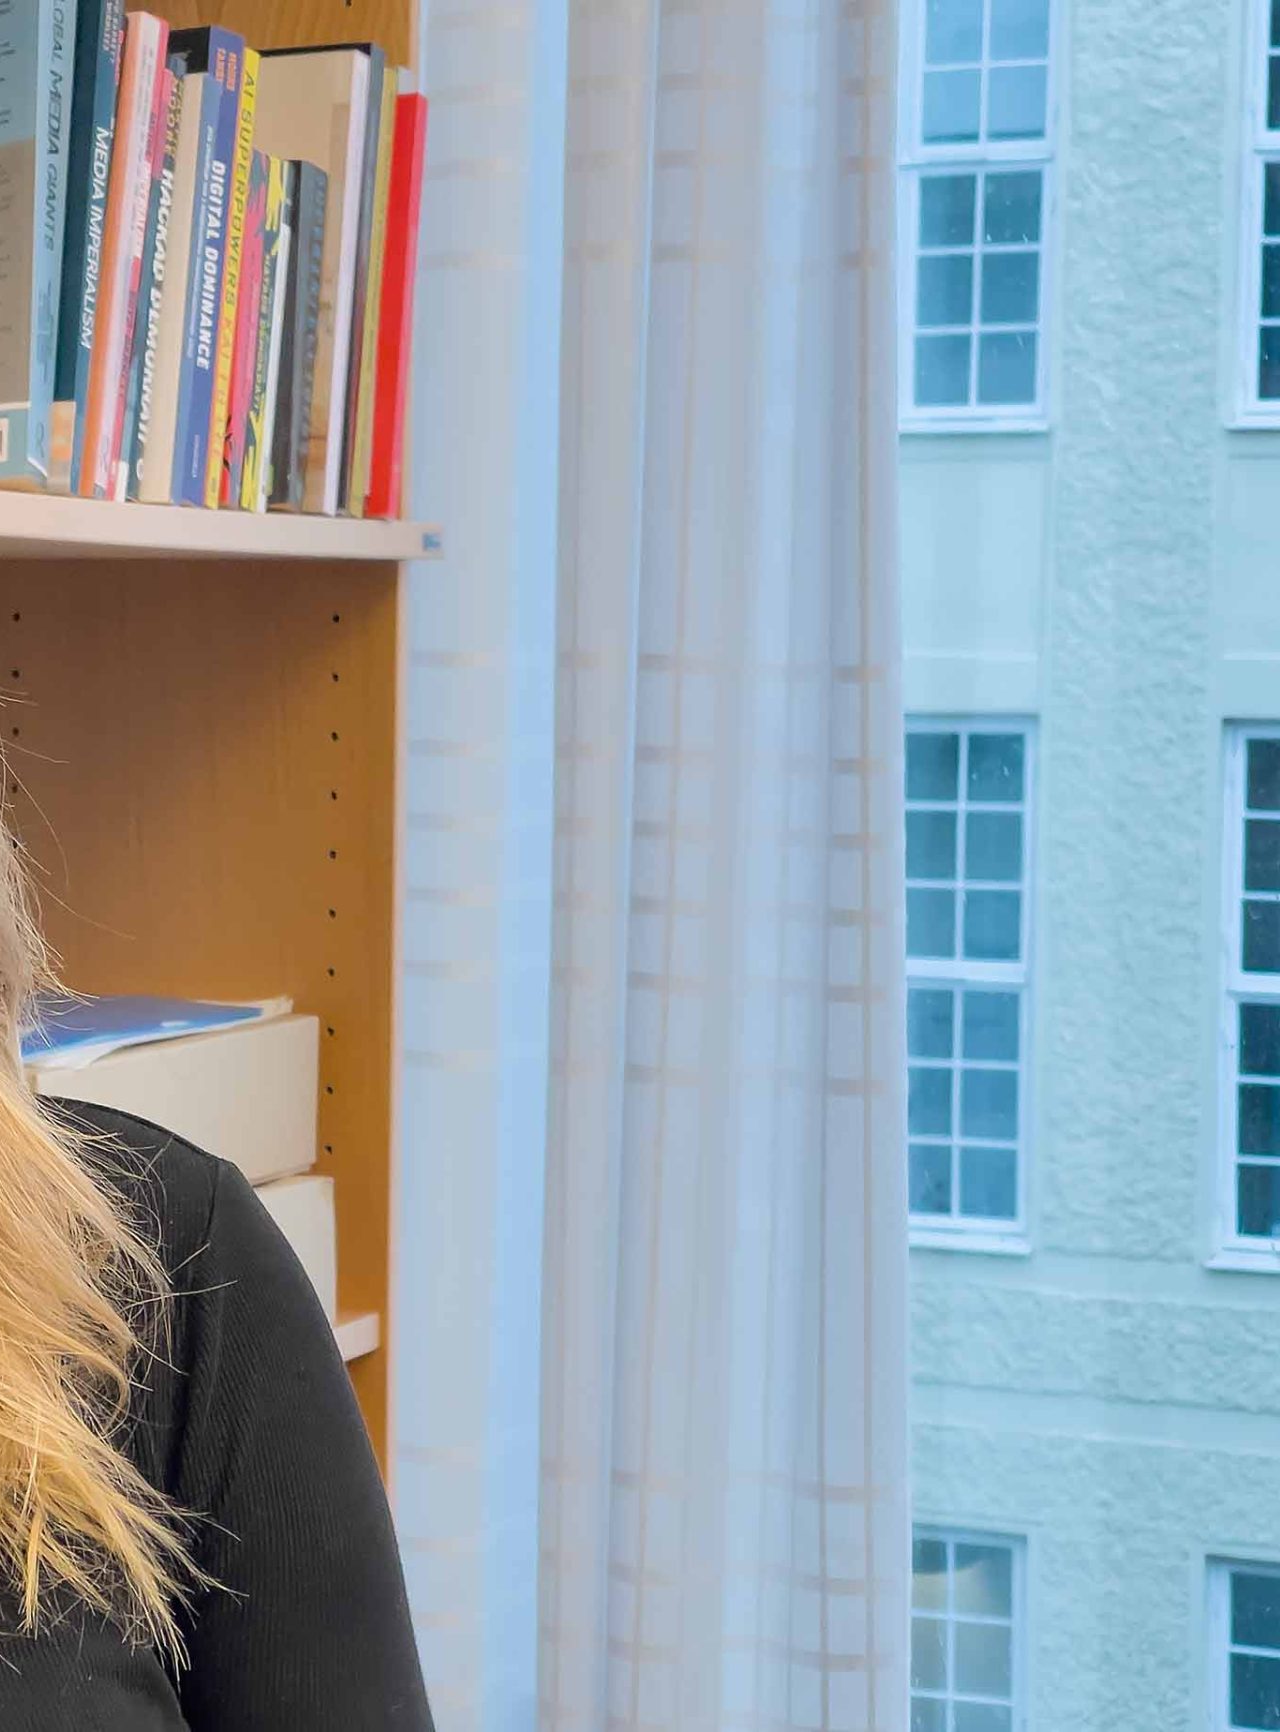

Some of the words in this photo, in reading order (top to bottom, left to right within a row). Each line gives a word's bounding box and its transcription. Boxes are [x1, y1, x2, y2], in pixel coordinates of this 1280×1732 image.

[47, 69, 63, 156] MEDIA
[243, 72, 256, 98] AI
[91, 126, 109, 200] MEDIA
[206, 160, 227, 240] DIGITAL
[226, 110, 254, 304] SUPERPOWERS
[152, 168, 174, 281] HACKAD
[81, 204, 105, 350] IMPERIALISM
[197, 250, 219, 371] DOMINANCE
